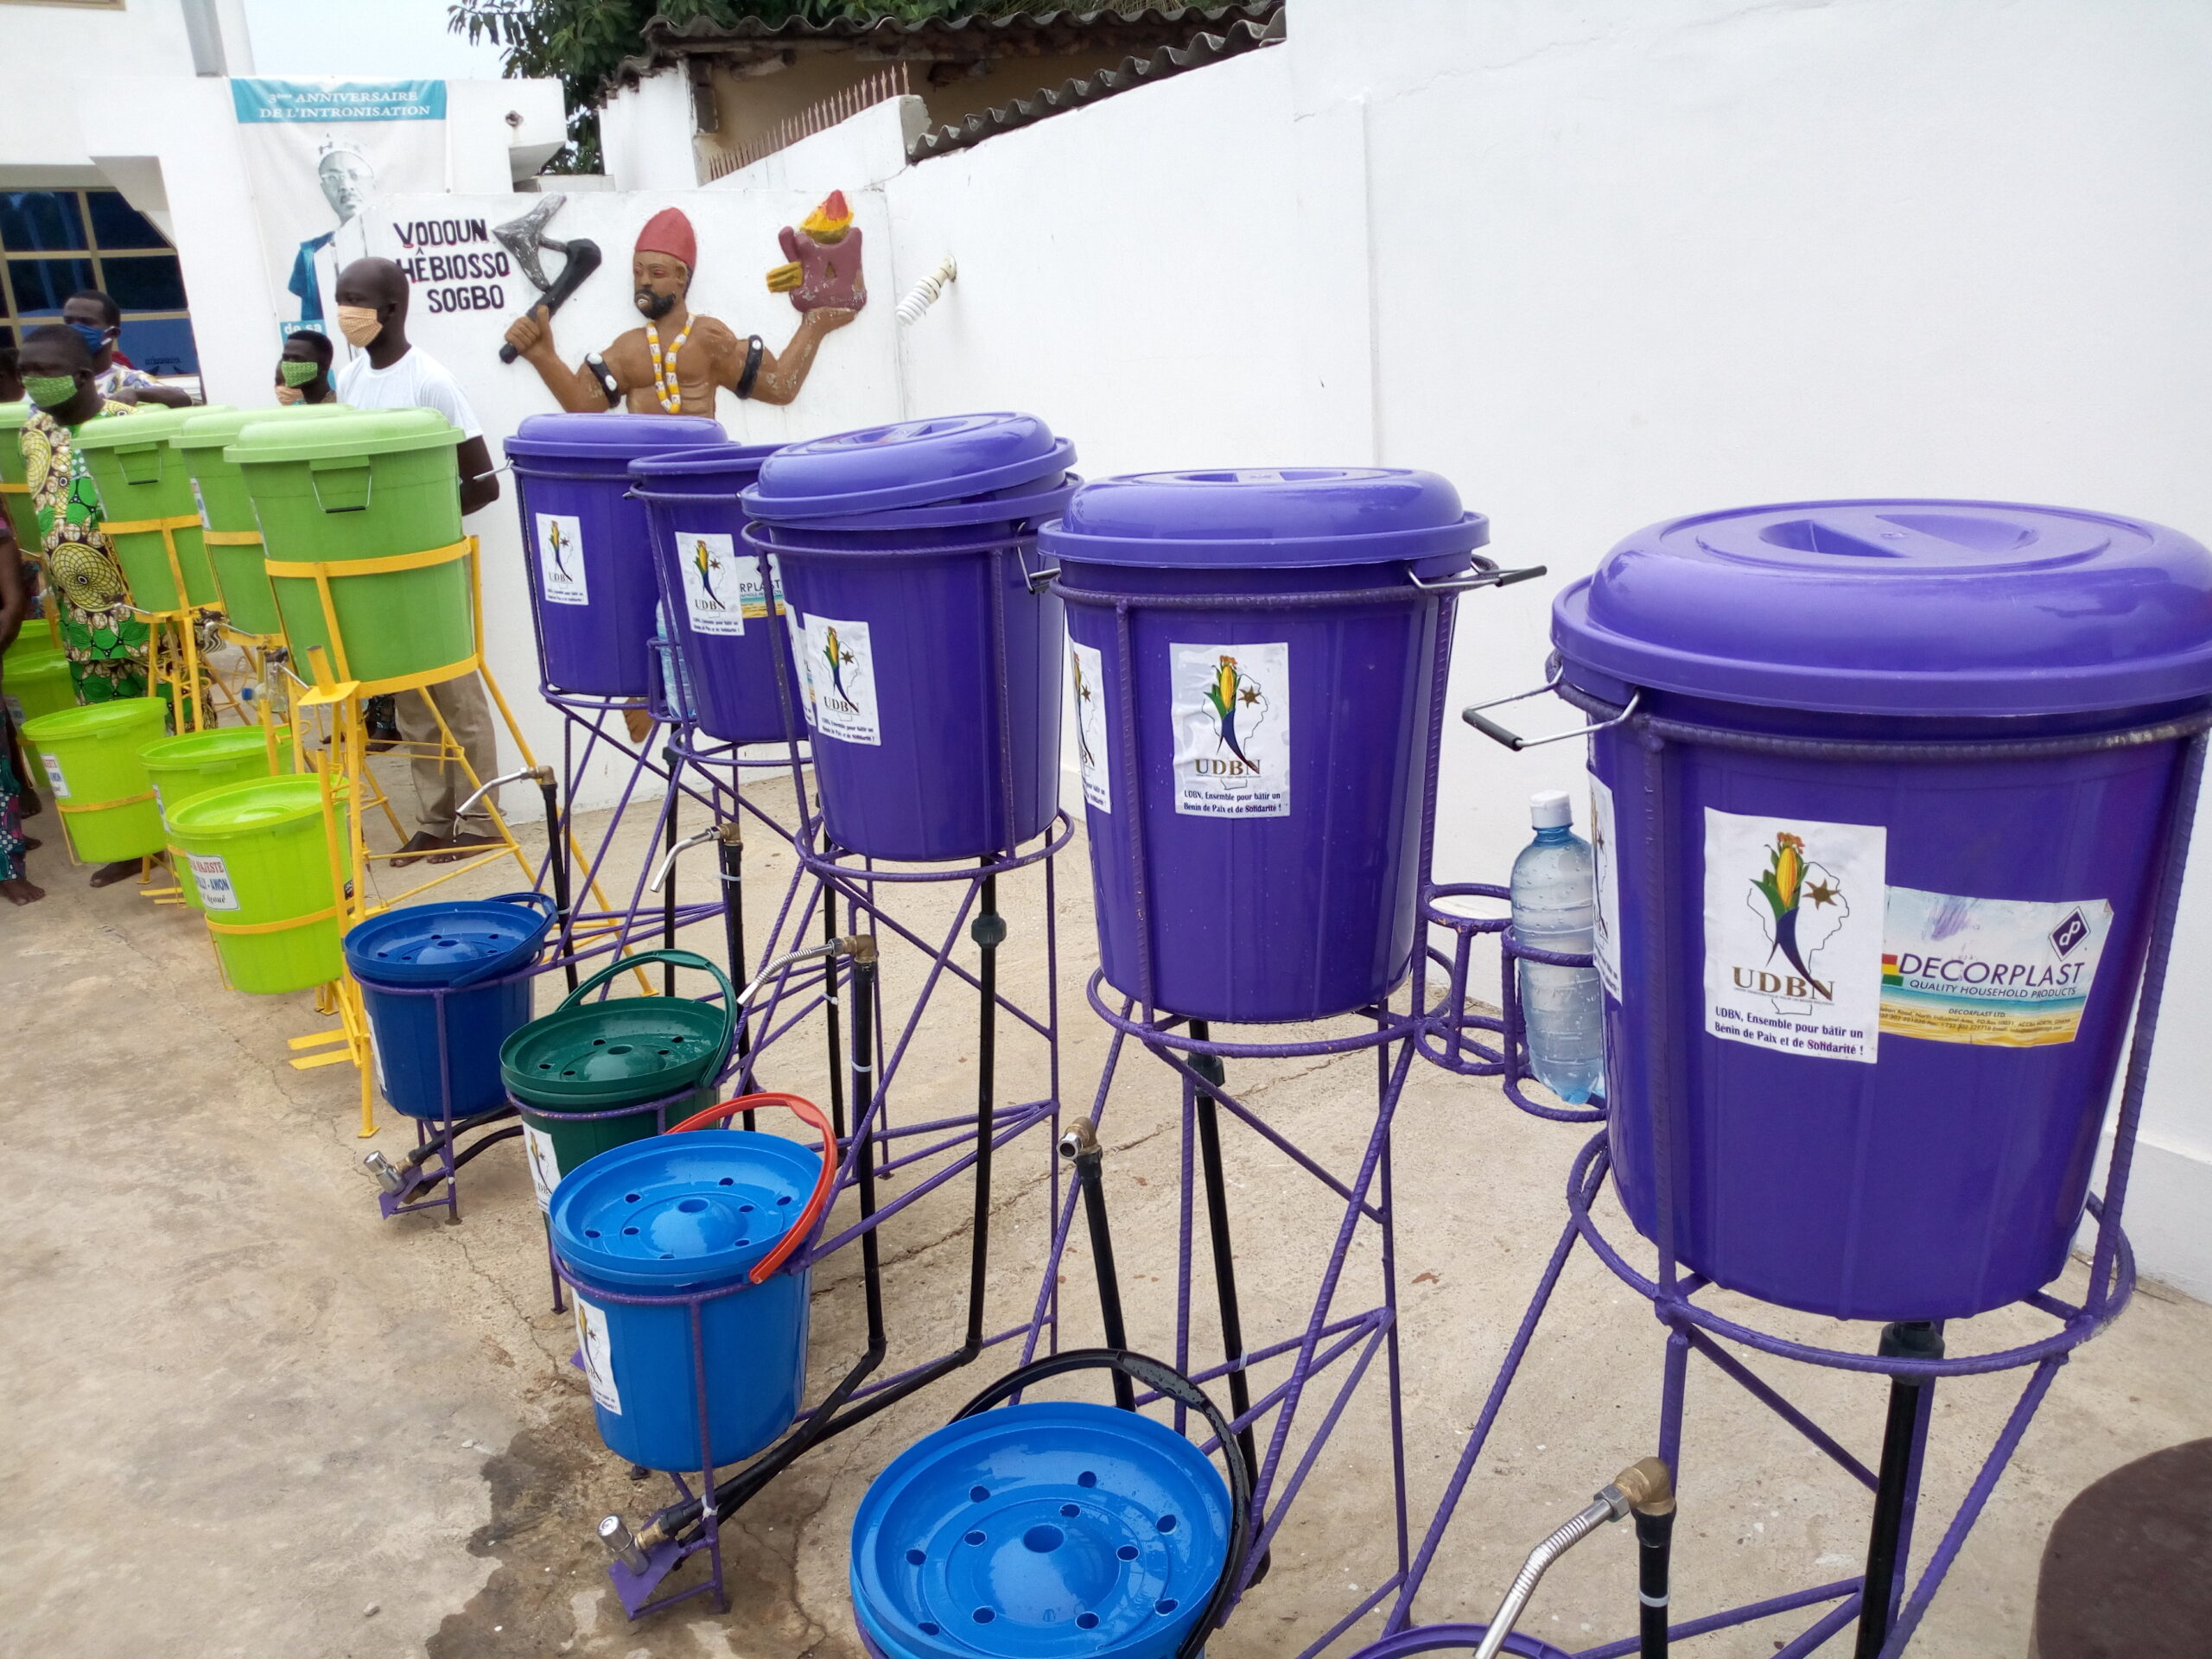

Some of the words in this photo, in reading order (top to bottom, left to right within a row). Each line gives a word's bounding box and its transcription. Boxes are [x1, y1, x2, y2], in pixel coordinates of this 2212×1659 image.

[296, 92, 418, 103] ANNIVERSAIRE
[260, 107, 283, 118] DE
[286, 105, 430, 118] L'INTRONISATION
[393, 219, 488, 245] VODOUN
[427, 284, 505, 313] SOGBO
[695, 599, 726, 611] UDBN
[823, 696, 860, 713] UDBN
[1195, 759, 1261, 775] UDBN
[1205, 791, 1235, 800] Ensemble
[1899, 953, 2085, 987] DECORPLAST
[1732, 966, 1835, 1001] UDBN
[1910, 979, 1958, 993] QUALITY
[1961, 986, 2028, 998] HOUSEHOLD
[2031, 987, 2075, 999] PRODUCTS
[1948, 1008, 1992, 1017] DECORPLAST
[1715, 1006, 1744, 1021] UDBN,
[1747, 1012, 1792, 1030] Ensemble
[1796, 1022, 1819, 1035] pour
[1822, 1024, 1847, 1037] bâtir
[1851, 1029, 1863, 1039] un
[1744, 1028, 1754, 1039] de
[1757, 1030, 1777, 1044] Paix
[1780, 1037, 1789, 1046] et
[1793, 1037, 1804, 1048] de
[1808, 1039, 1857, 1054] Solidarité
